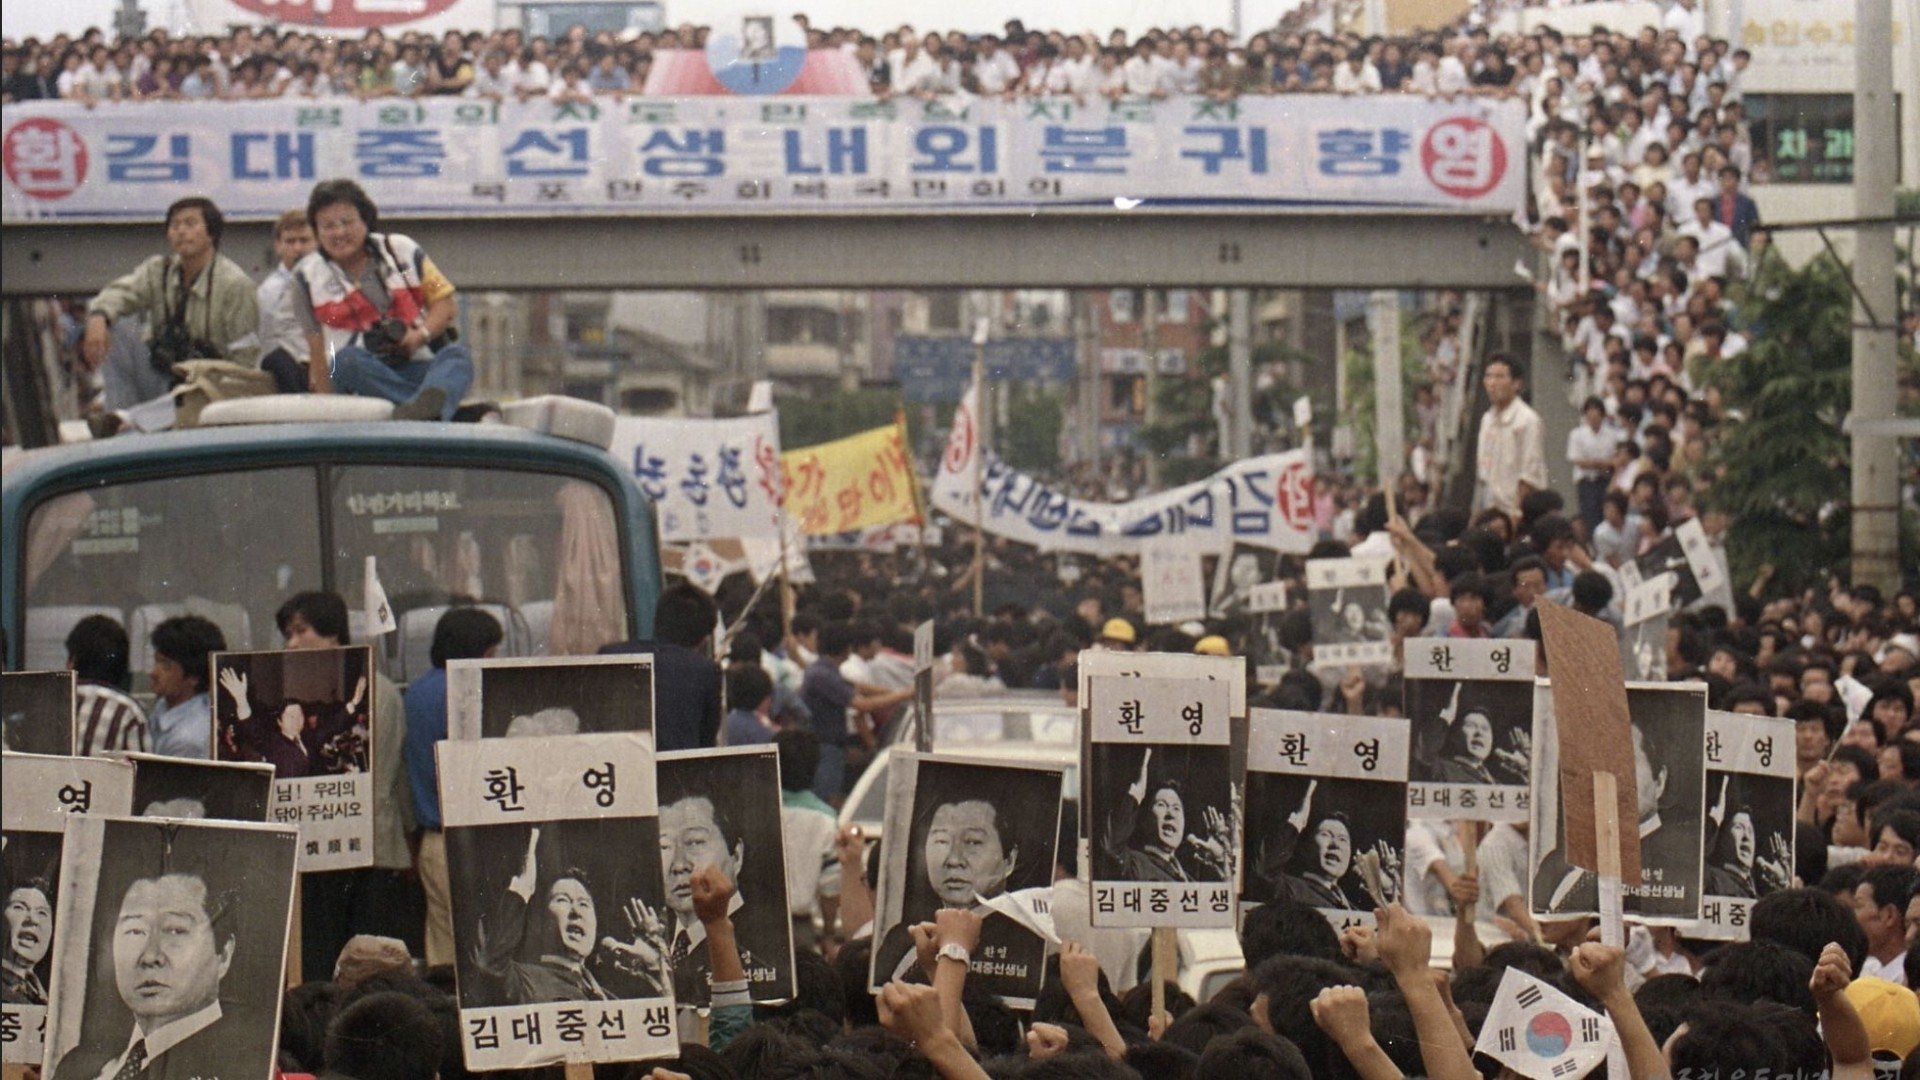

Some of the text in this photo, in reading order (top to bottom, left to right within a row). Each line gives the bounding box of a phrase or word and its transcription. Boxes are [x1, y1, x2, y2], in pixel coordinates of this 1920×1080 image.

[12, 122, 84, 192] 환
[1427, 121, 1500, 193] 영
[314, 780, 356, 799] 우리의
[307, 802, 362, 821] 주십시오
[1097, 887, 1230, 913] 김대중선생
[971, 961, 1028, 977] 대중선생님
[470, 1006, 671, 1050] 김대중선생
